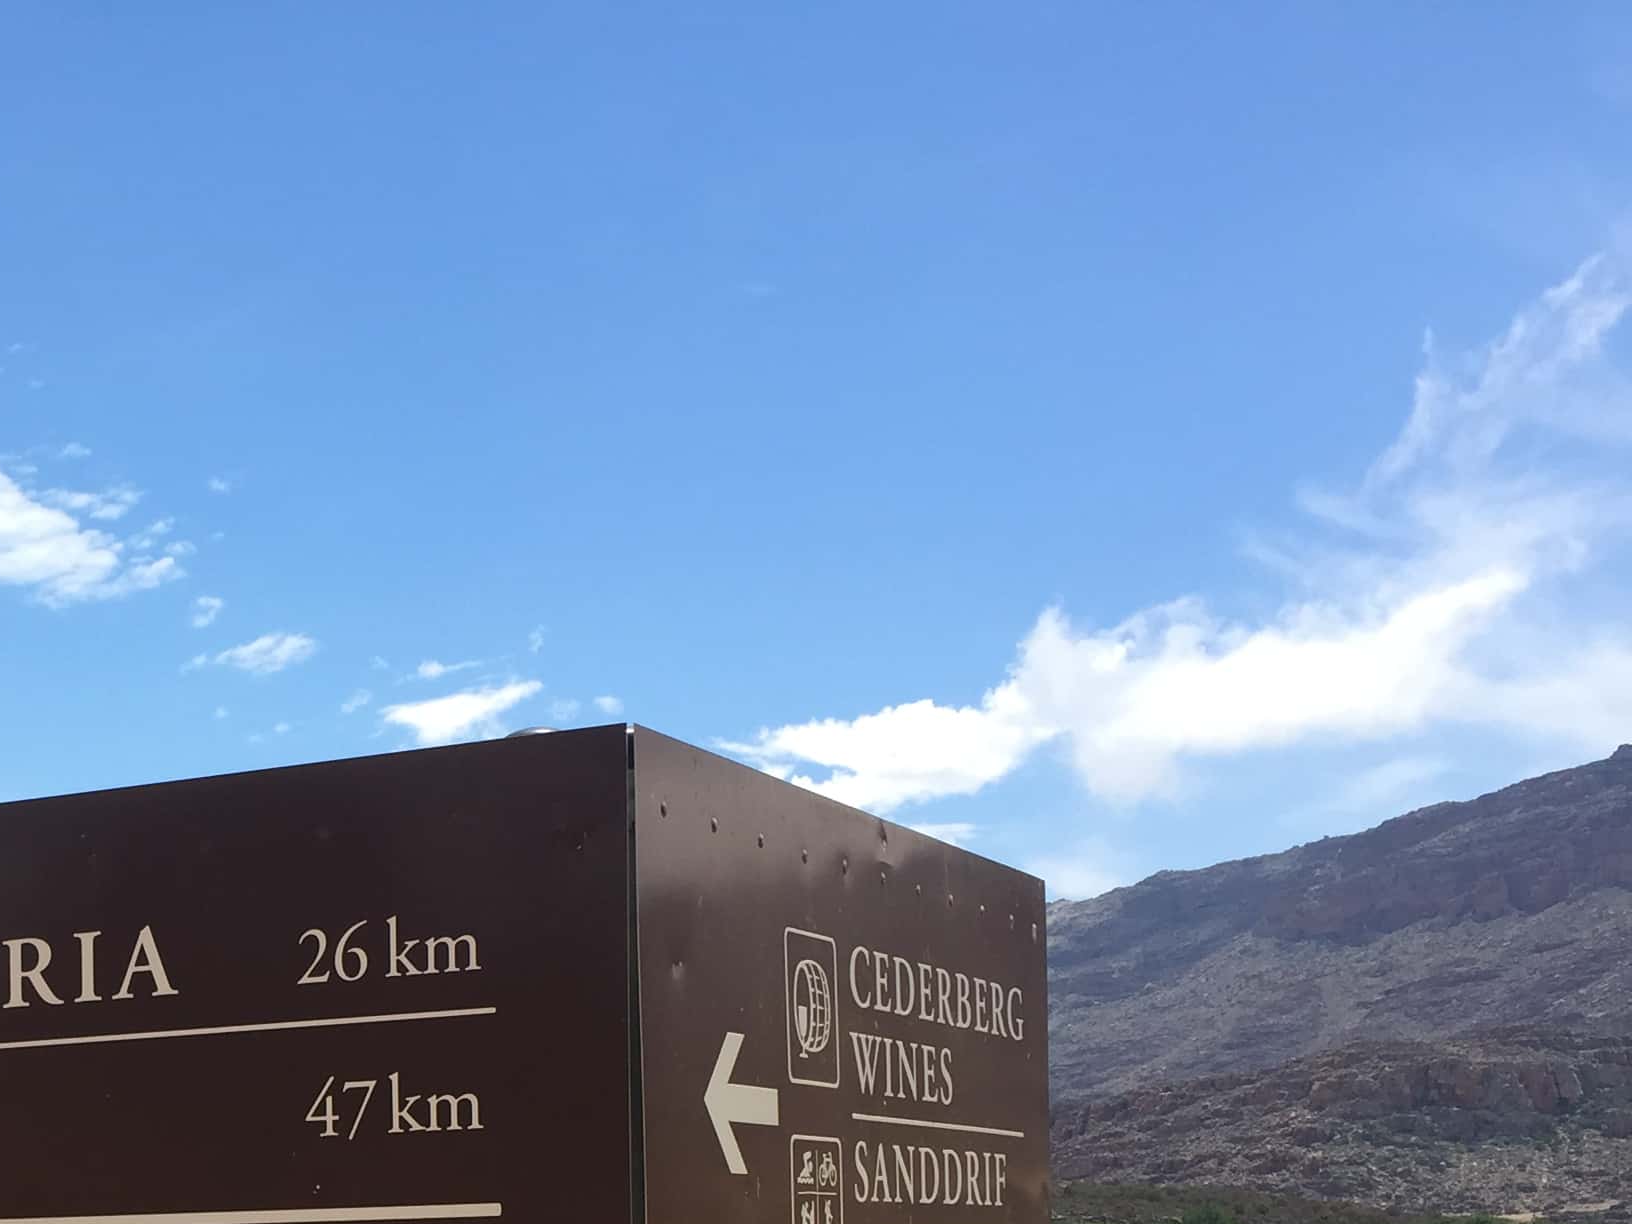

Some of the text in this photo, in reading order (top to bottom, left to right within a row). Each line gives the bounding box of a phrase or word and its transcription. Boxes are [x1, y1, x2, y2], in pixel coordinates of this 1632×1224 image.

[297, 920, 367, 984] 26
[385, 916, 481, 977] km
[850, 946, 1023, 1040] CEDERBERG
[849, 1032, 952, 1105] WINES
[305, 1076, 377, 1140] 47
[388, 1072, 484, 1133] km
[855, 1141, 1006, 1206] SANDDRIF
